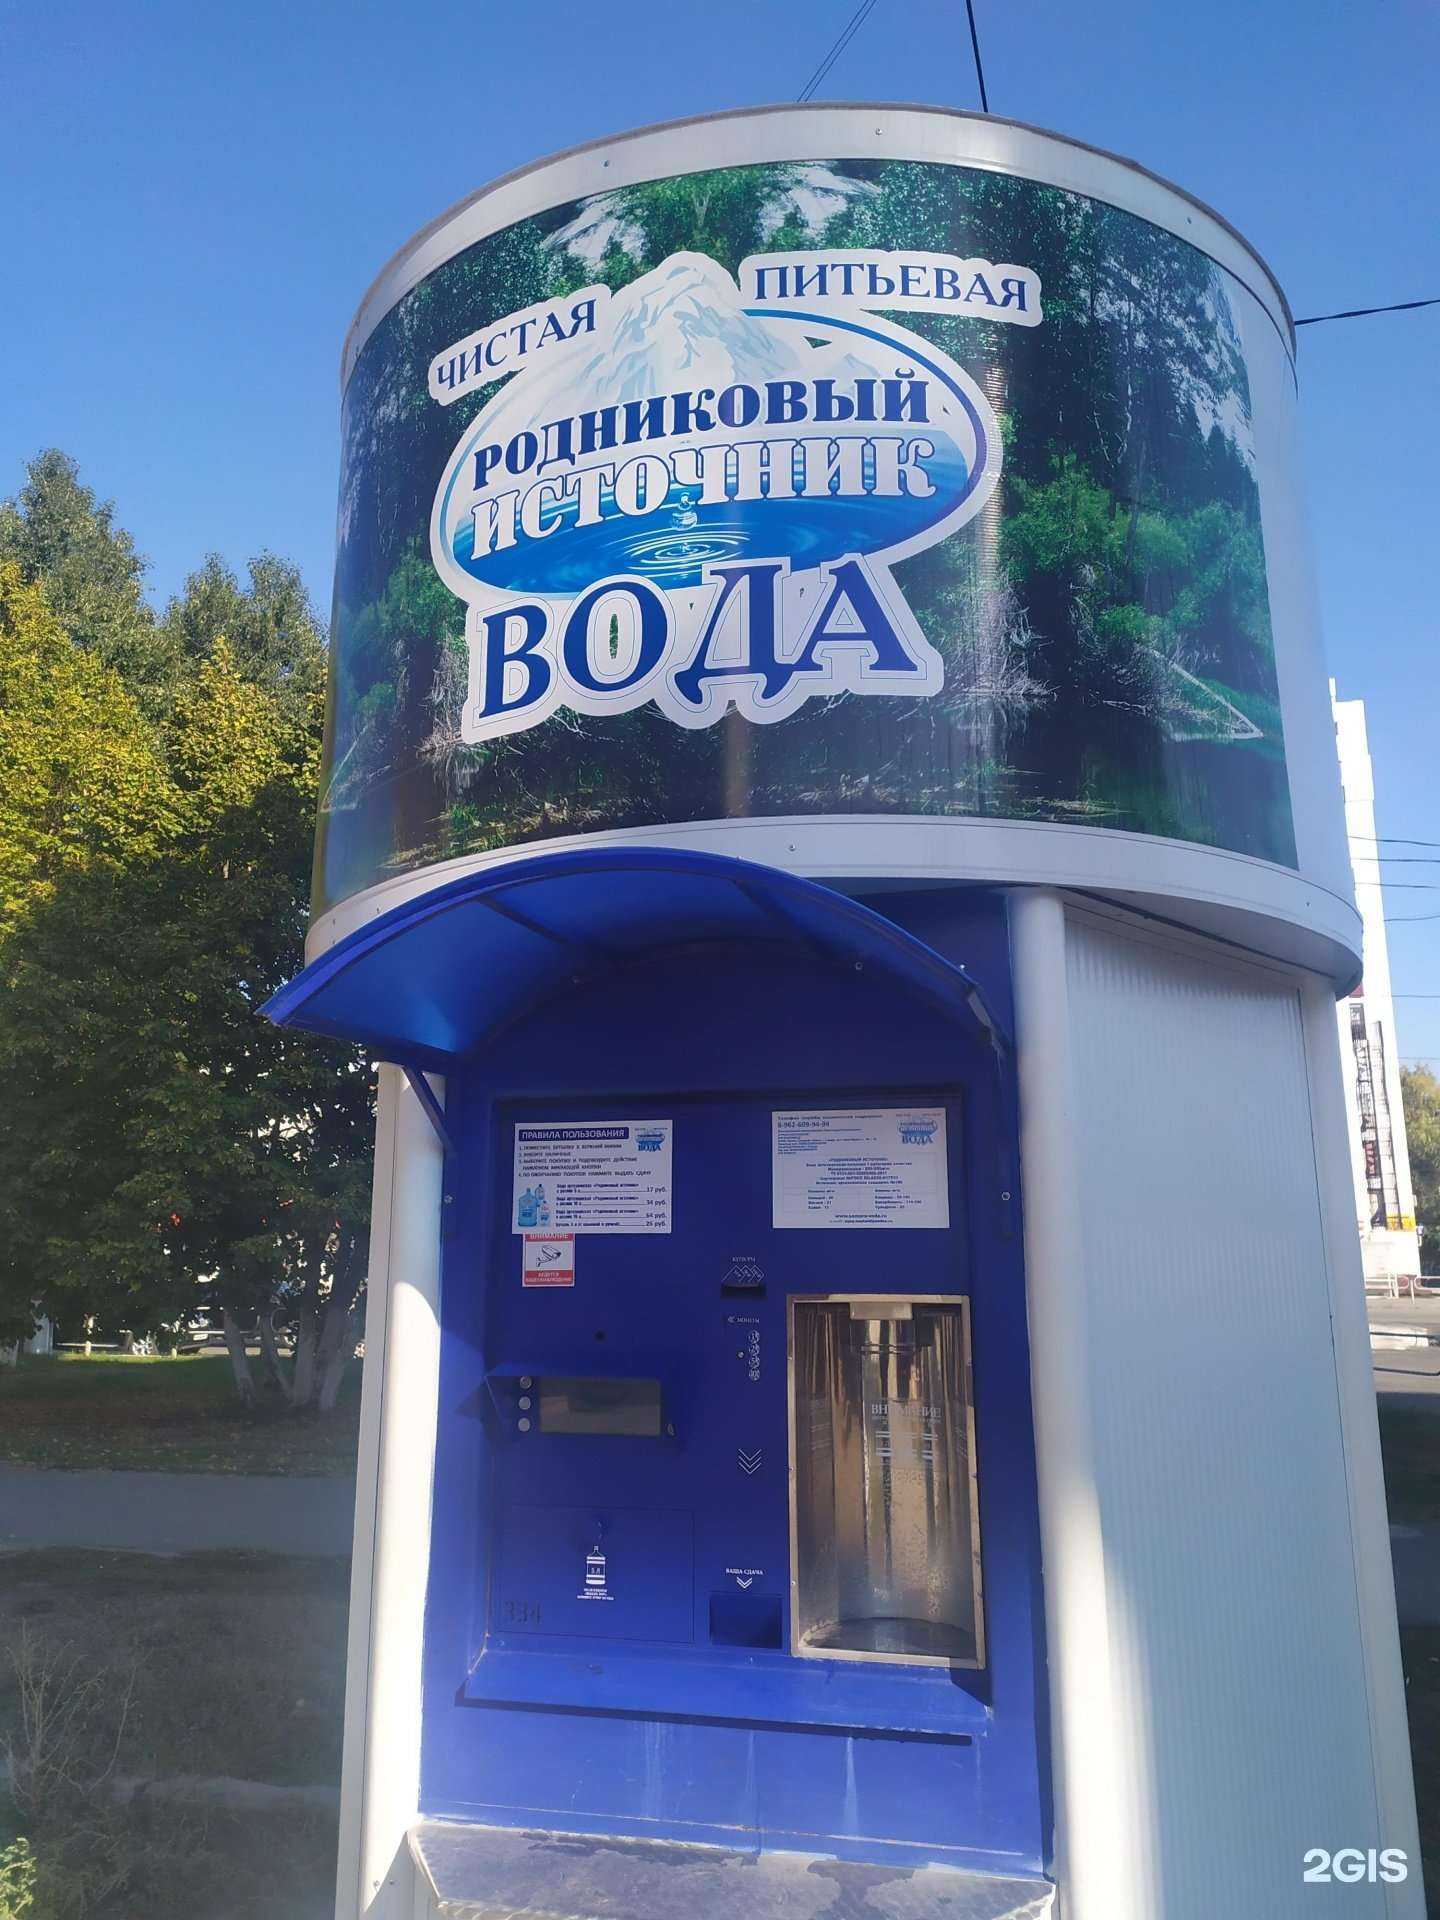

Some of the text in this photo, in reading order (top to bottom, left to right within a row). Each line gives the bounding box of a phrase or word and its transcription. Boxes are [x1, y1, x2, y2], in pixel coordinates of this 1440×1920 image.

[756, 264, 1028, 312] ПИТЬЕВАЯ
[437, 299, 597, 391] ЧИСТАЯ
[472, 369, 930, 491] РОДНИКОВЫЙ
[470, 436, 937, 561] ИСТОЧНИК
[478, 560, 920, 719] ВОДА
[522, 1129, 560, 1140] ПРАВИЛА
[562, 1128, 625, 1139] ПОЛЬЗОВАНИЯ
